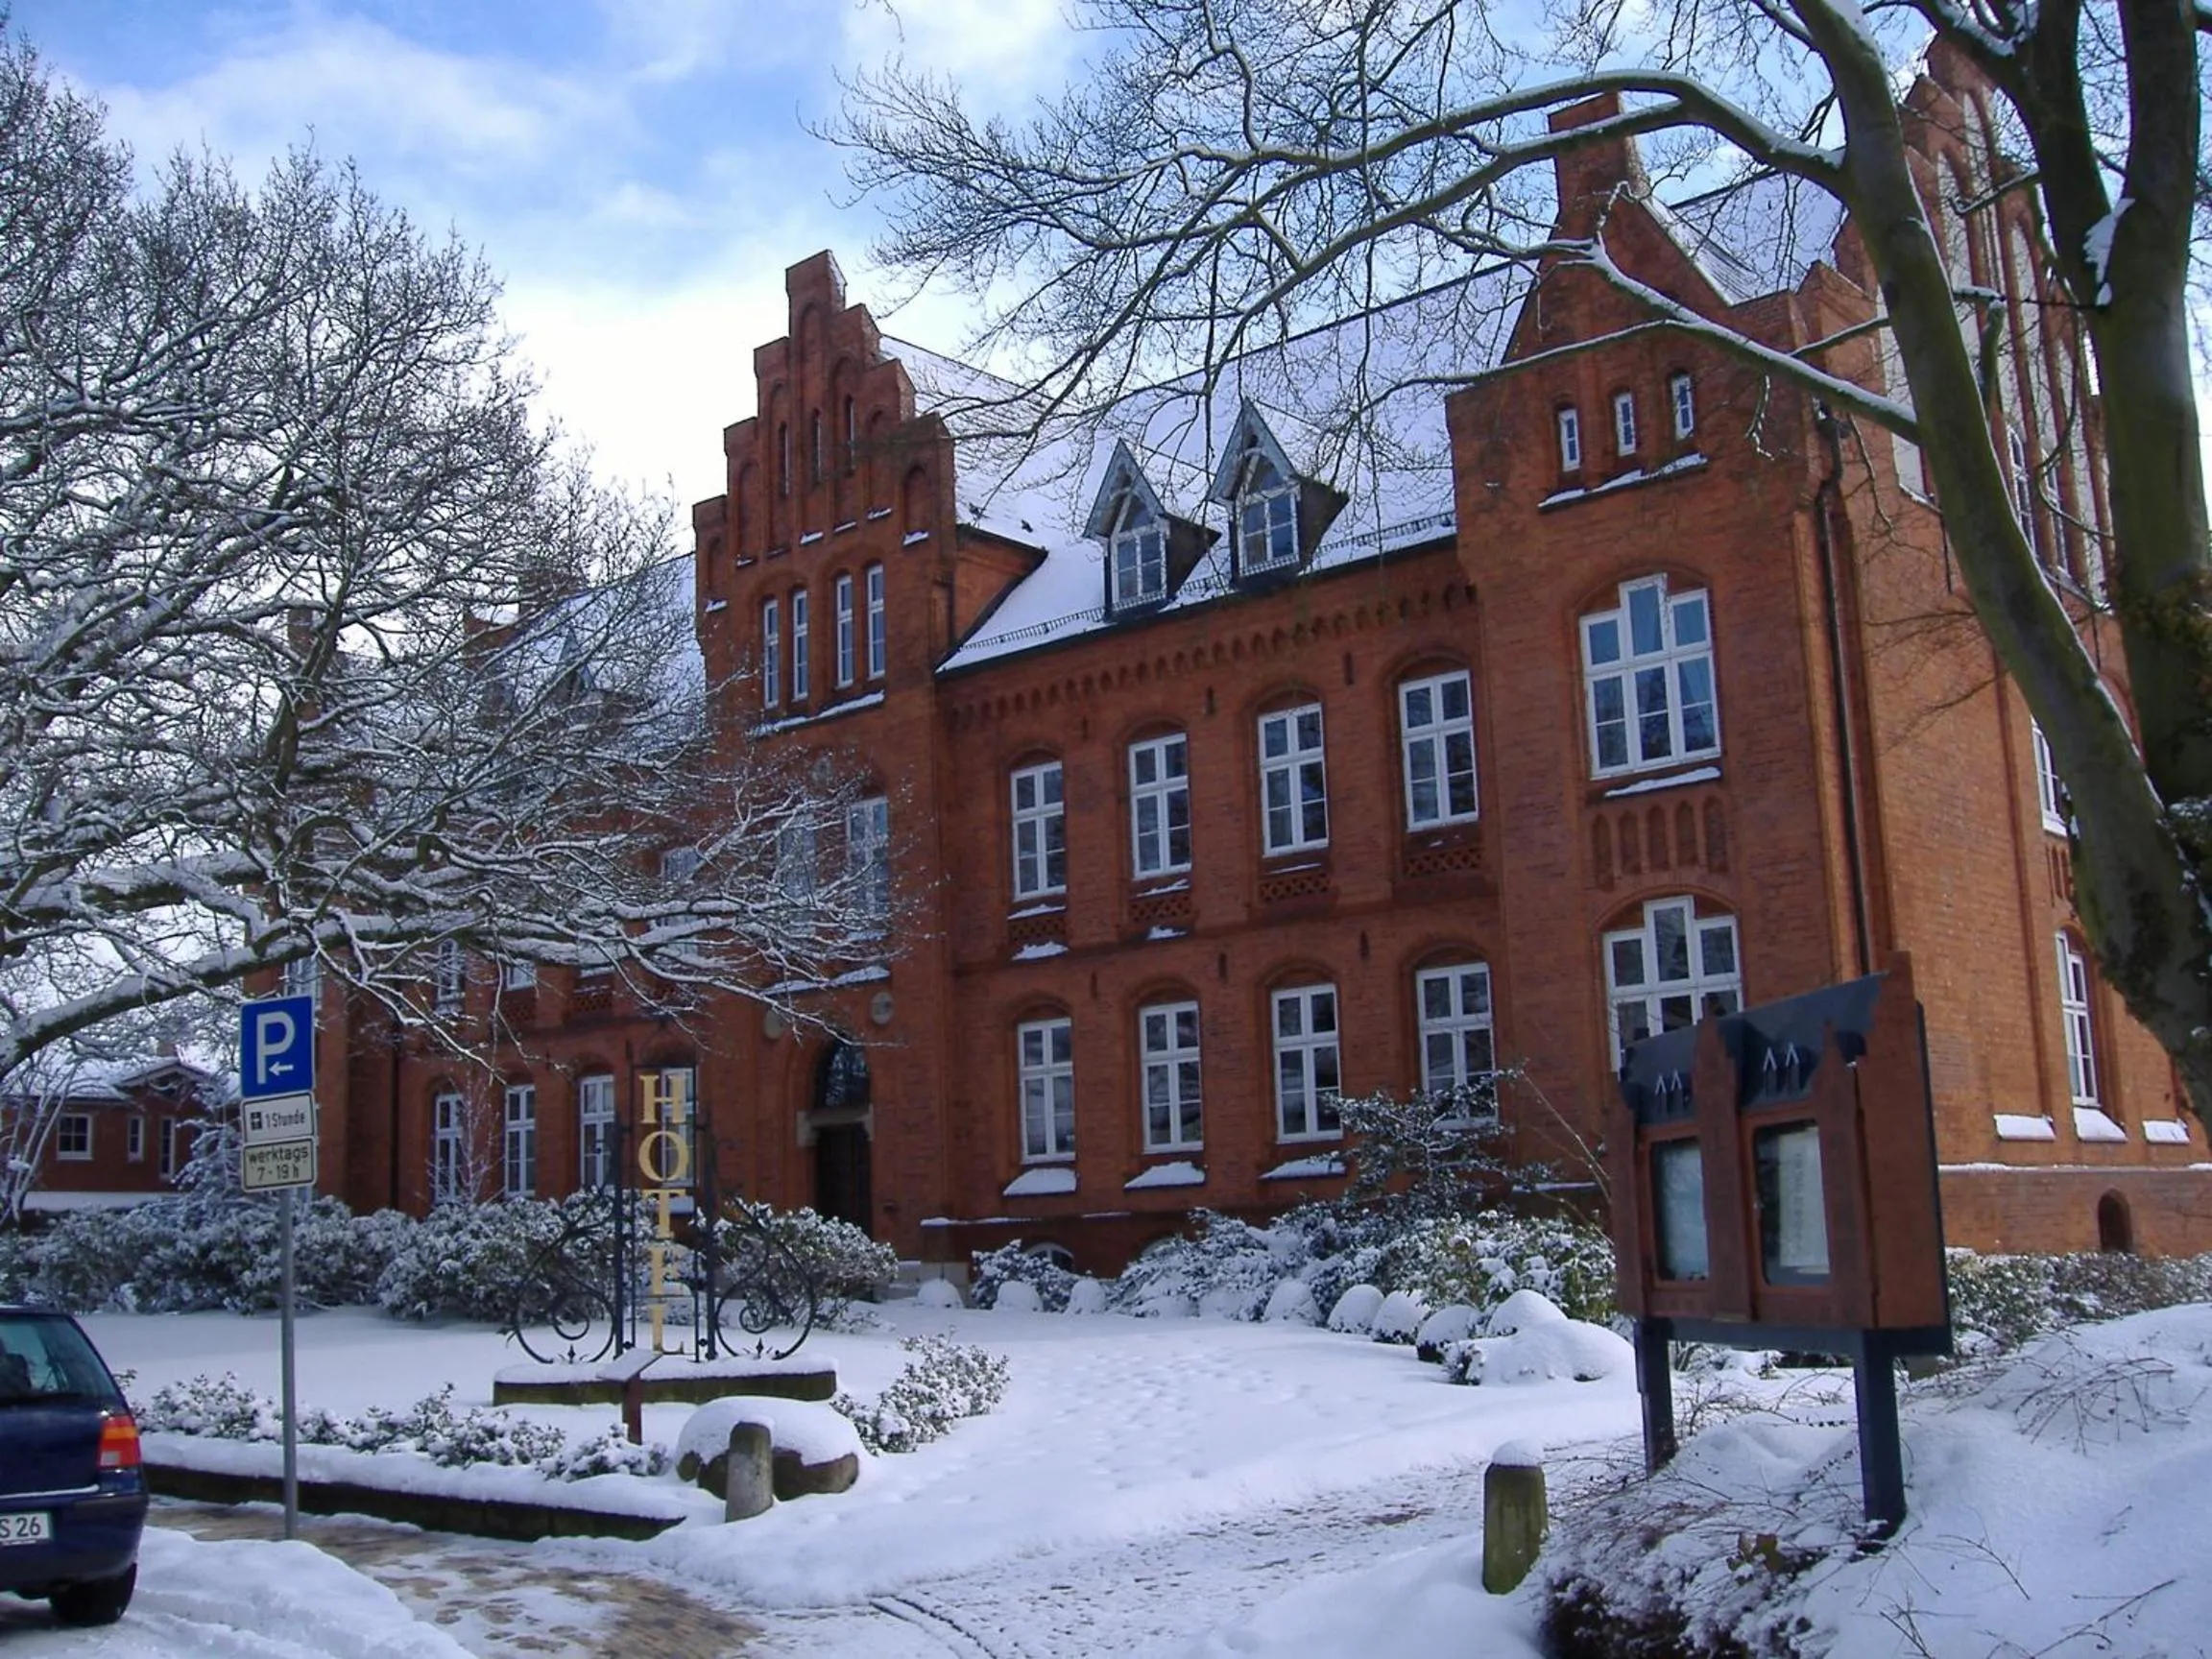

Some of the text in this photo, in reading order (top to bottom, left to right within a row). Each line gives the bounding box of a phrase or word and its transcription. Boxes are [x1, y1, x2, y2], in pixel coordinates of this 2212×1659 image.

[256, 1011, 295, 1084] P
[272, 1109, 305, 1127] Stunde
[249, 1144, 308, 1165] werktags
[637, 1074, 689, 1355] HOTEL
[15, 1517, 41, 1538] 26
